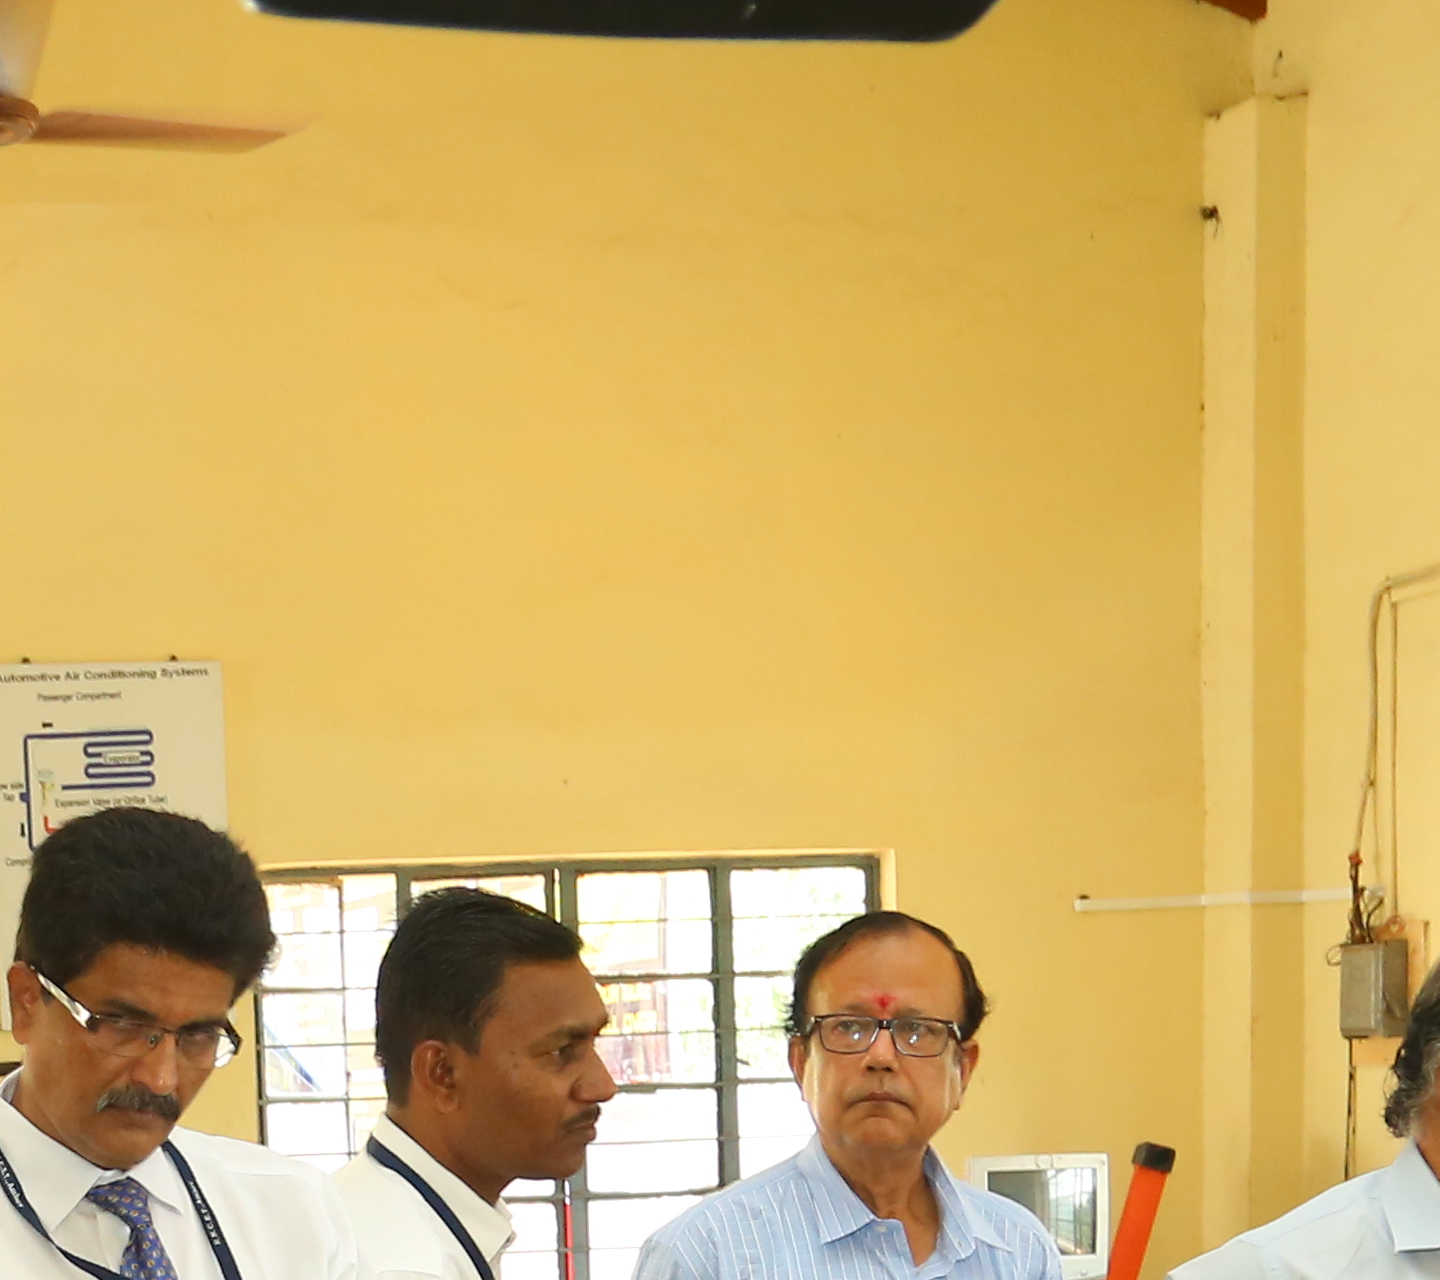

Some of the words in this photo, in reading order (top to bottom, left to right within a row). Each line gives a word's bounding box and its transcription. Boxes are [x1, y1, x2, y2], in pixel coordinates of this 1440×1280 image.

[64, 672, 80, 682] Air
[84, 668, 157, 681] Conditioning
[160, 667, 209, 679] Systems
[76, 690, 122, 701] Compartment
